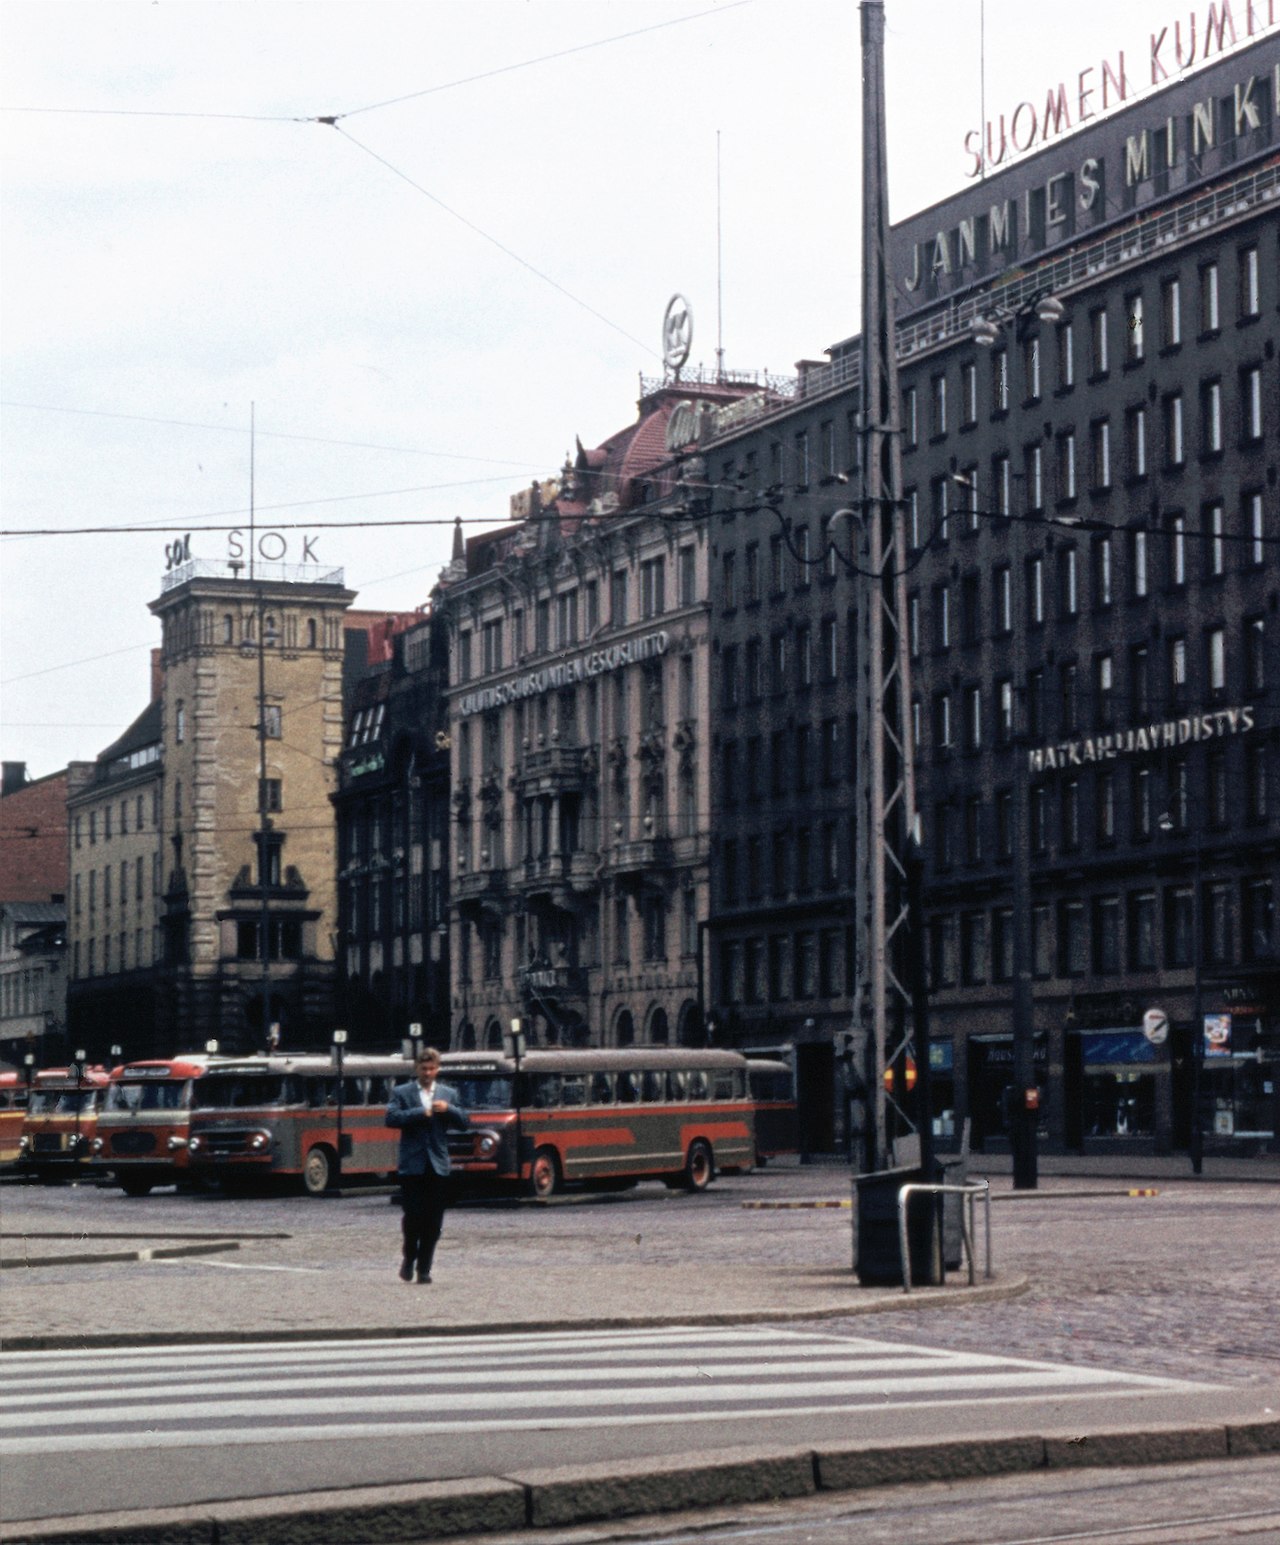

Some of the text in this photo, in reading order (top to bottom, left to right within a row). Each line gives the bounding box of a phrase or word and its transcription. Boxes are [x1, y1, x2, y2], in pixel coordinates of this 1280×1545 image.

[964, 50, 1127, 178] SUOMEN
[904, 157, 1100, 291] JANMIES
[165, 533, 191, 570] SOK
[228, 530, 319, 563] SOK
